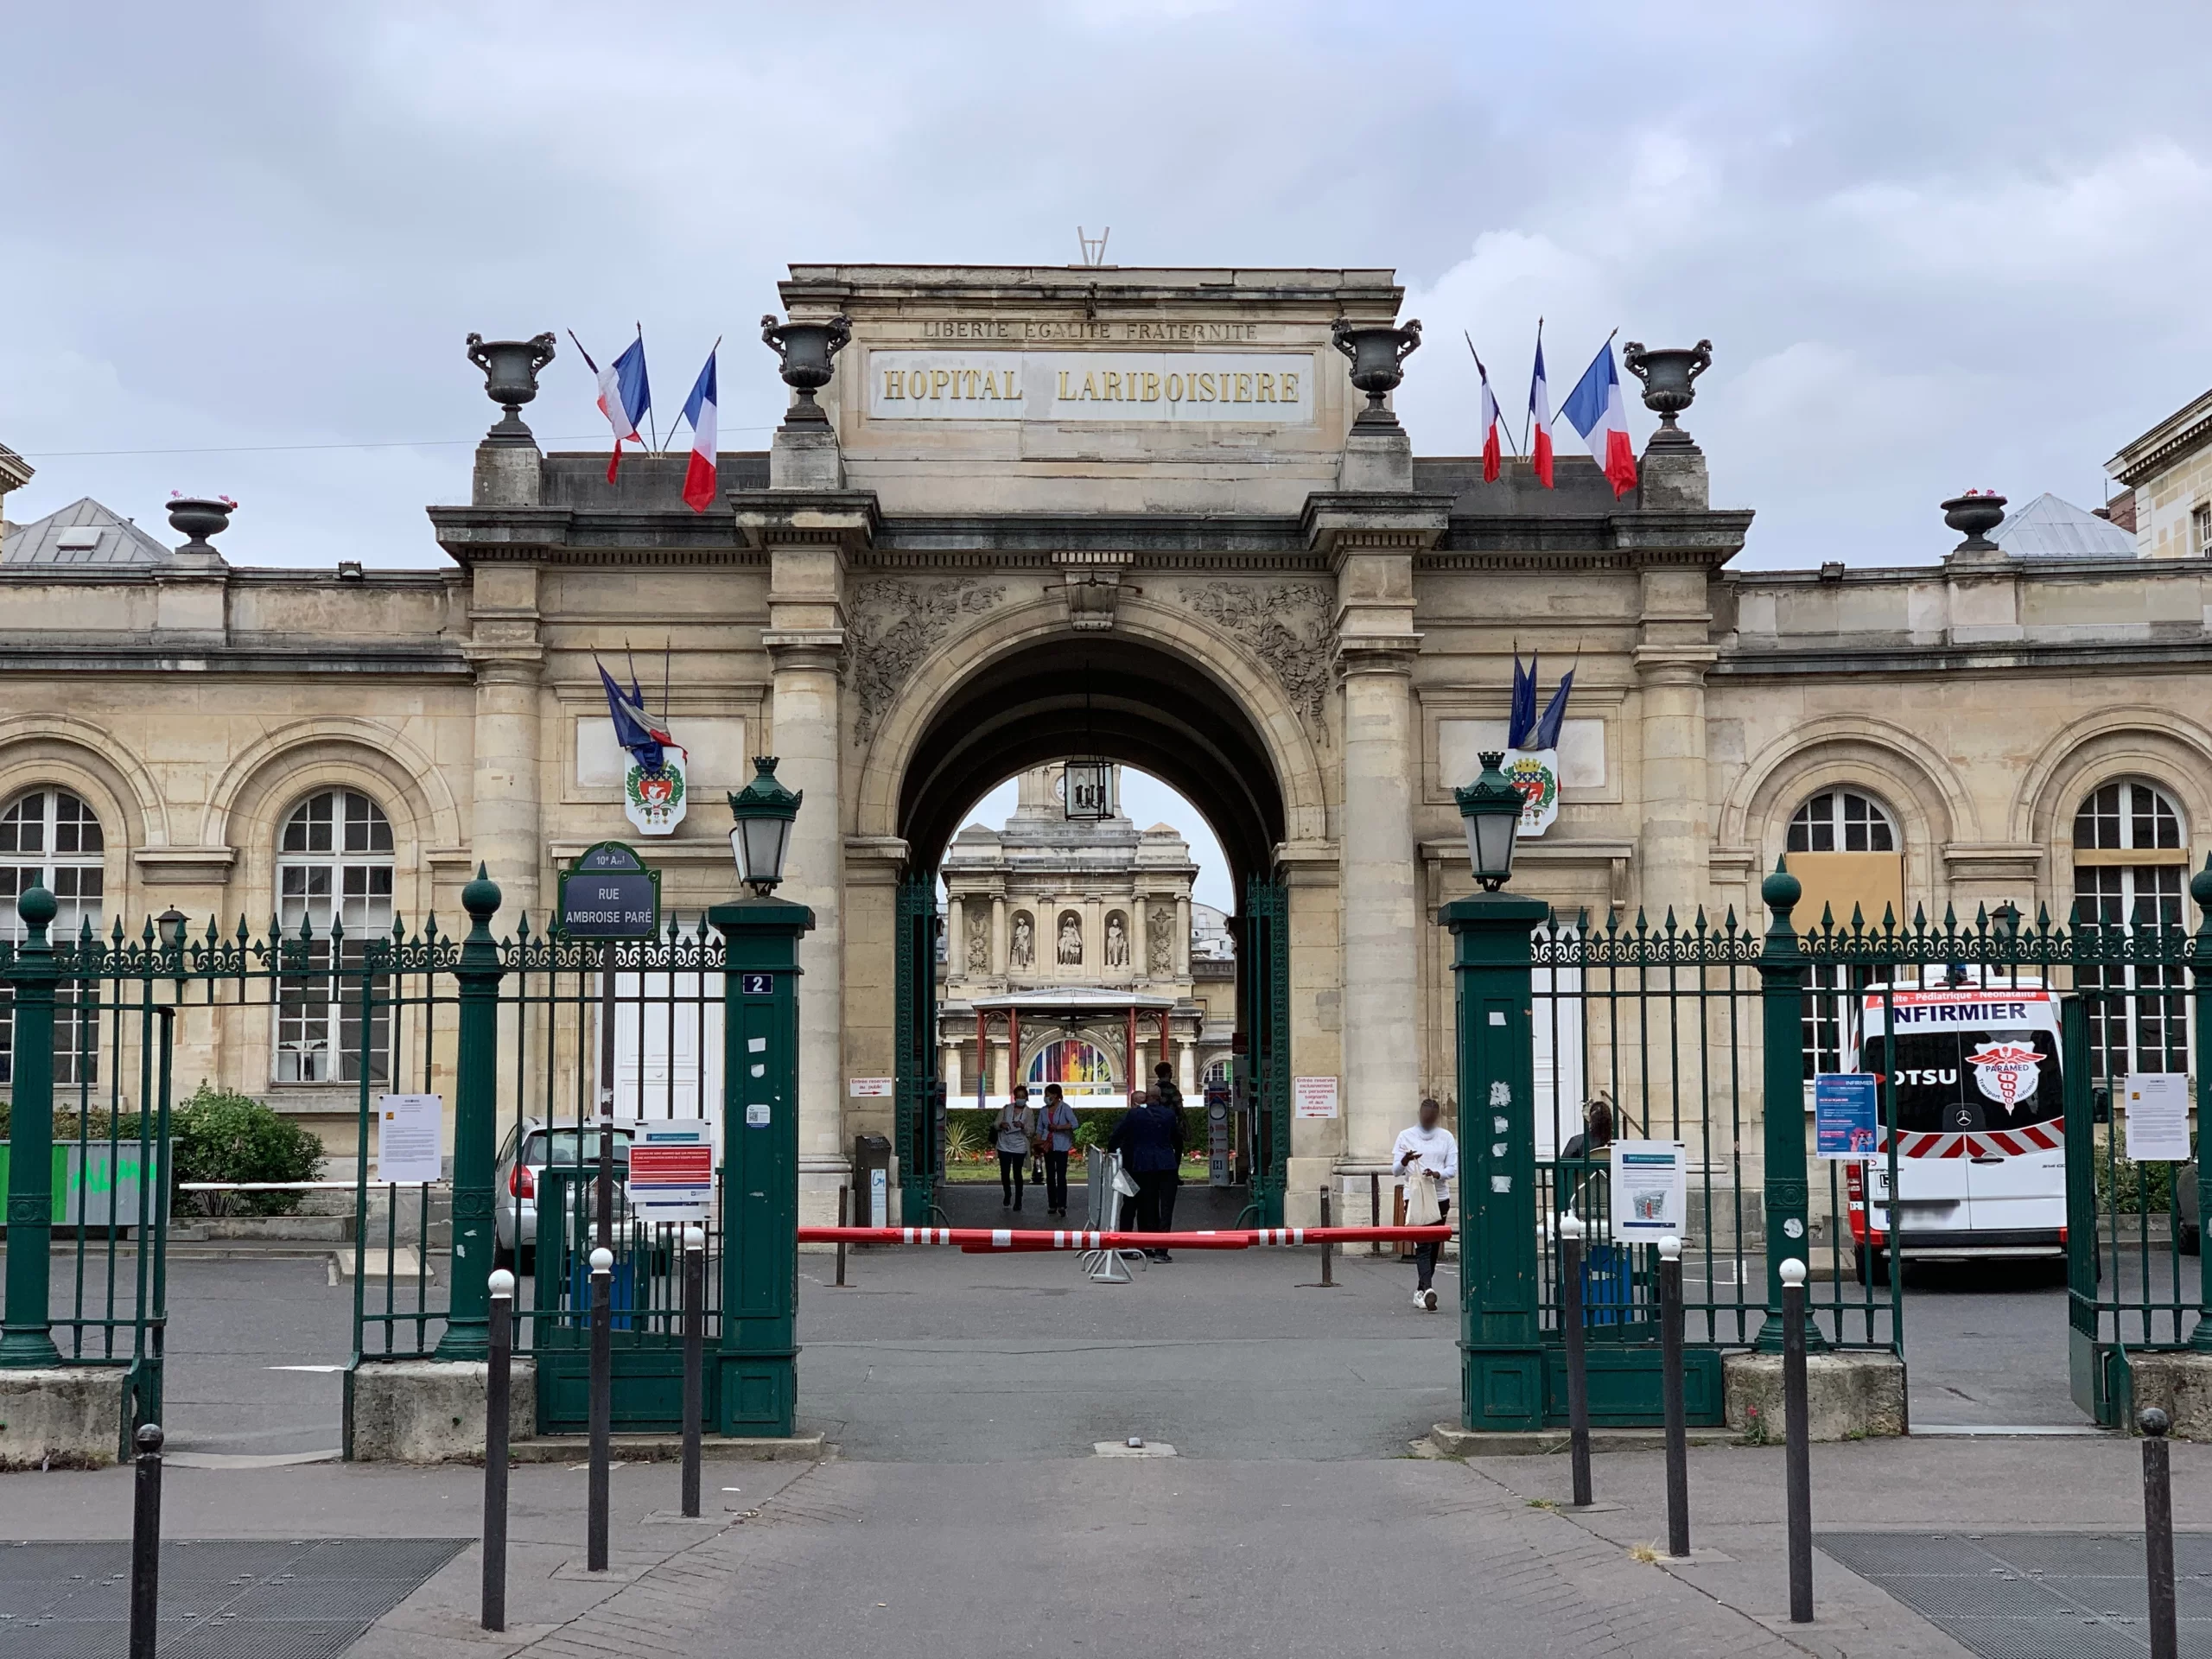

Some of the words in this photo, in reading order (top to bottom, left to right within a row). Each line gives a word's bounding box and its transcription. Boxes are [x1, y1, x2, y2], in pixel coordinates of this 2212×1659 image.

[923, 322, 1009, 338] LIBERTE
[1024, 322, 1111, 339] EGALITE
[1126, 323, 1258, 340] FRATERNITE
[883, 370, 1023, 400] HOPITAL
[1058, 371, 1300, 403] LARIBOISIERE
[598, 887, 620, 899] RUE
[565, 911, 620, 924] AMBROISE
[625, 907, 652, 924] PARÉ
[753, 976, 763, 992] 2
[1877, 994, 1908, 1004] Alte
[1916, 992, 1973, 1001] Pédiatrique
[1894, 1002, 2028, 1023] NFIRMIER
[1985, 1064, 2030, 1072] PARAMED
[1979, 1078, 2001, 1100] Transport
[2017, 1077, 2037, 1098] Infirmier
